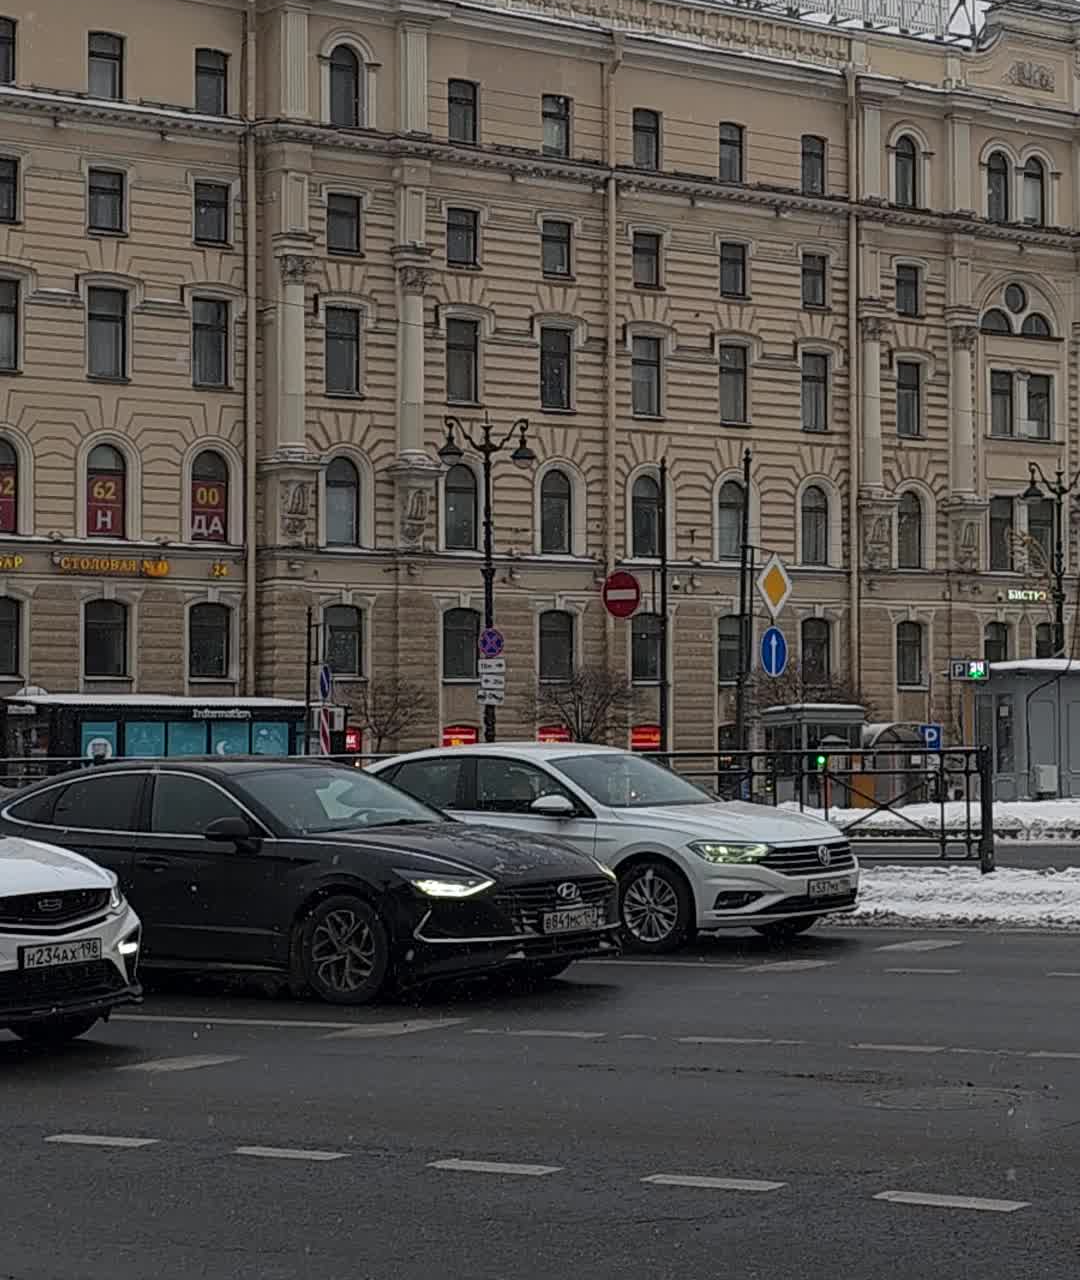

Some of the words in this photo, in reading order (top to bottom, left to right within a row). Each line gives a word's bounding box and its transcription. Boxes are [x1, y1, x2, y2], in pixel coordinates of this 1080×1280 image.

[93, 481, 116, 500] 62
[196, 487, 219, 505] 00
[191, 515, 224, 536] ДА
[61, 557, 136, 572] СТОЛОВАЯ
